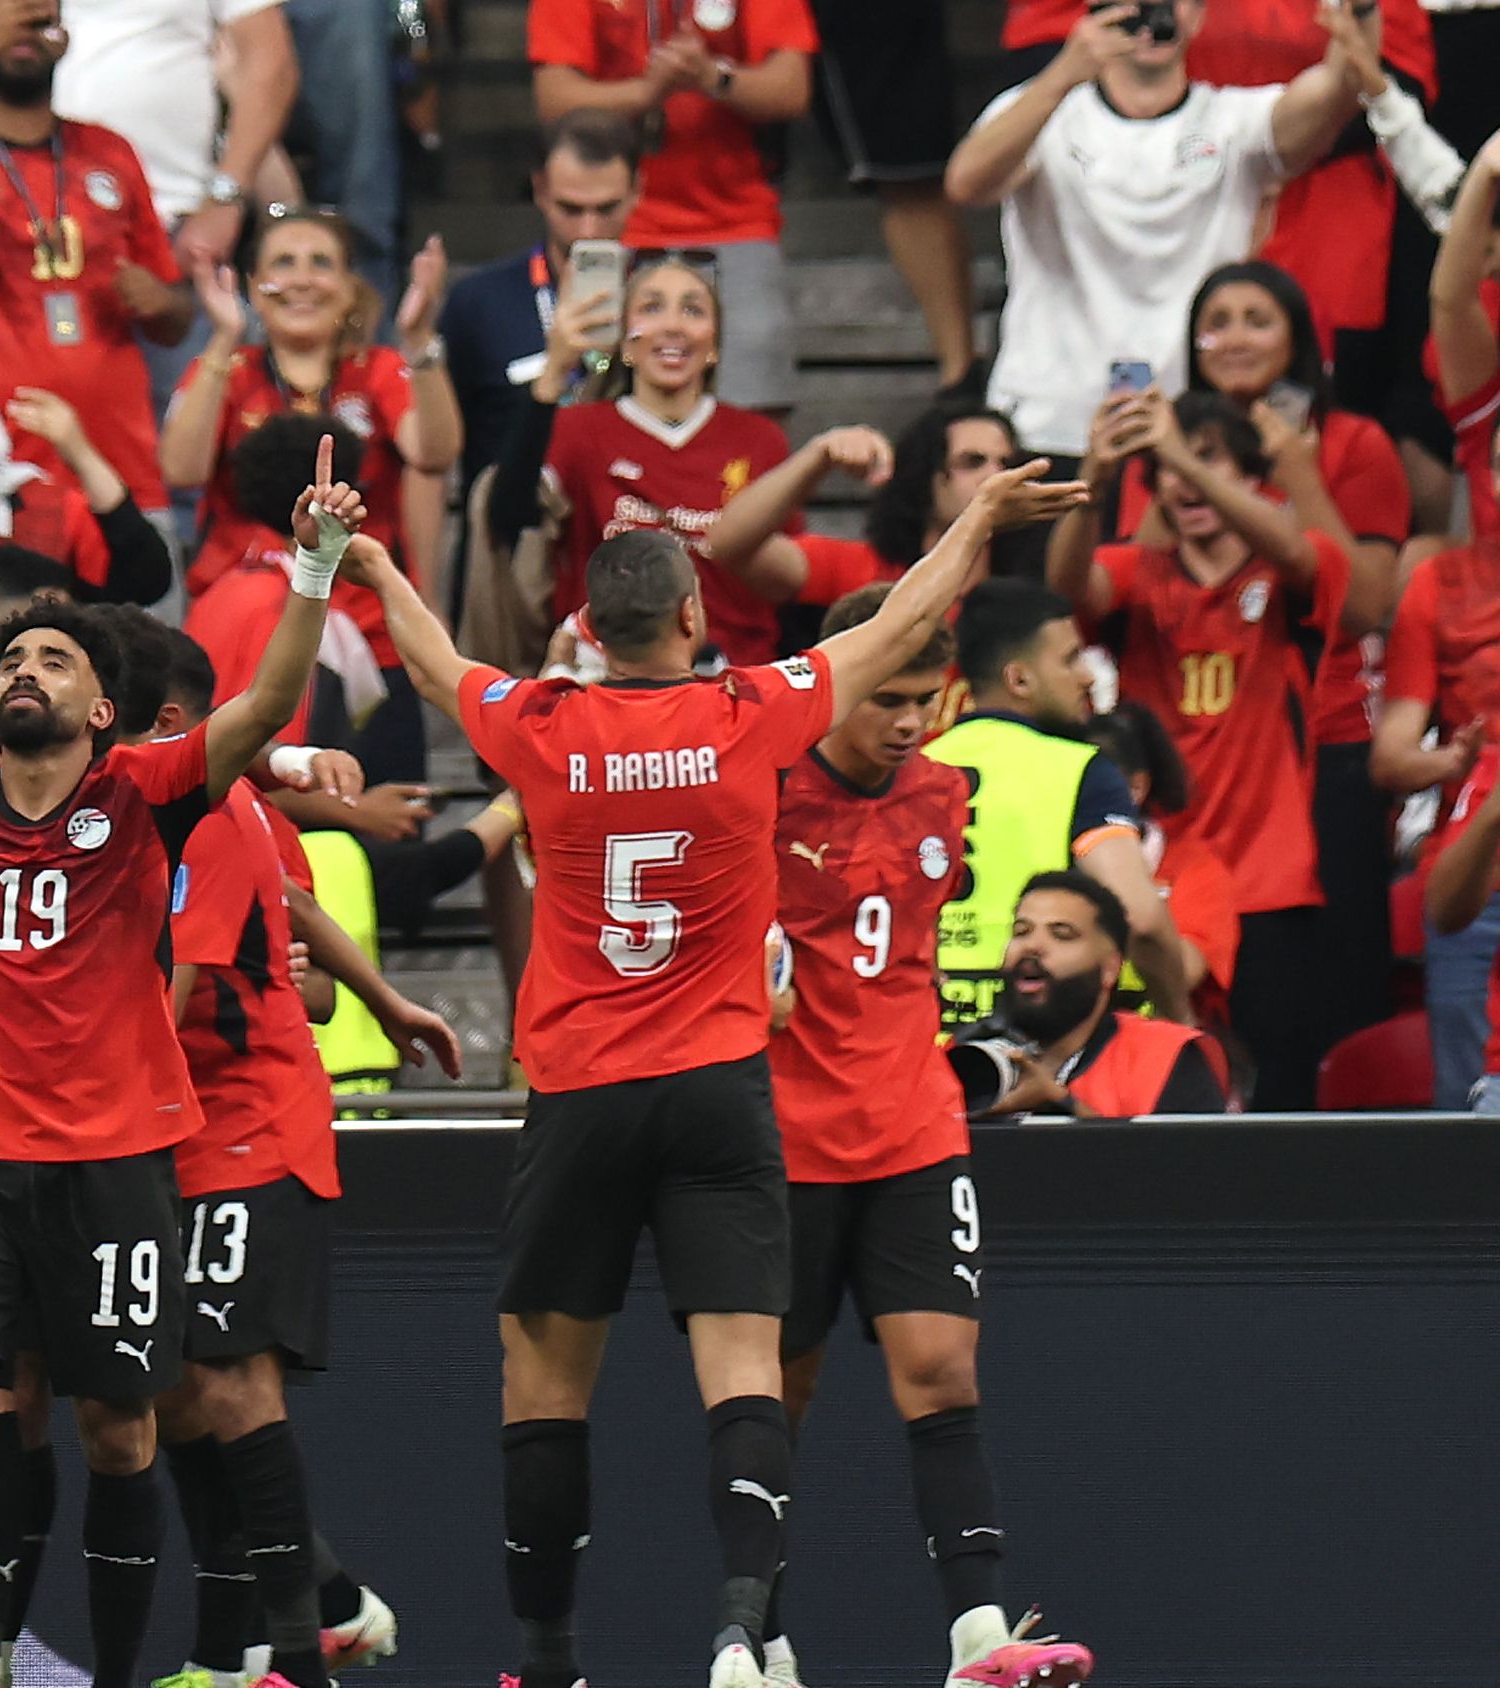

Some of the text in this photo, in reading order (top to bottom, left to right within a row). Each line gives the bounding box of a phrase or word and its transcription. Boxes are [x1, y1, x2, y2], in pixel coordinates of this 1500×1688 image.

[1178, 653, 1236, 717] 10
[568, 753, 596, 793] R.
[598, 830, 696, 979] 5
[852, 895, 892, 979] 9
[184, 1202, 250, 1284] 13
[951, 1175, 980, 1253] 9
[91, 1240, 160, 1327] 19
